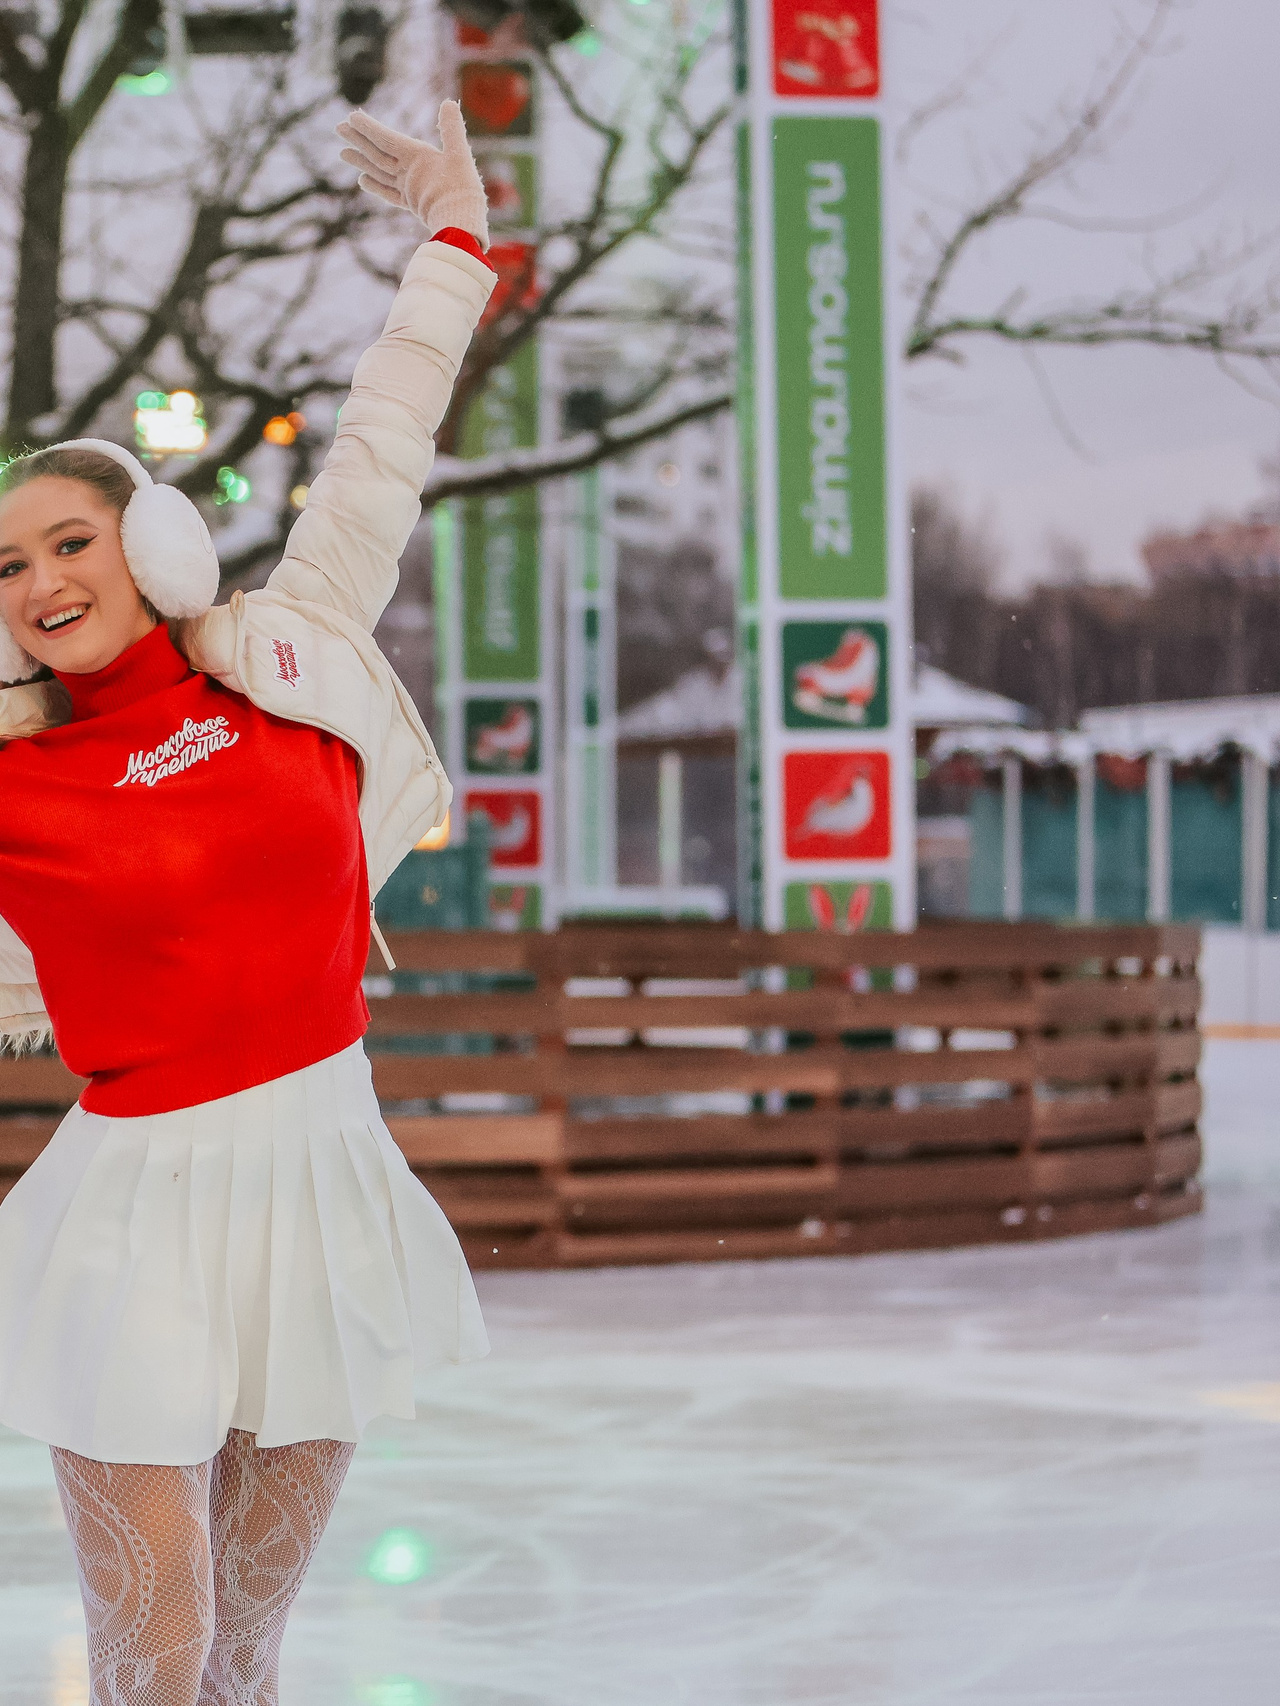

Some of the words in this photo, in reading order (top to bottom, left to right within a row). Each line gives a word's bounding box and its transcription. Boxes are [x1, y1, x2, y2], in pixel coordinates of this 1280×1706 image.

[802, 161, 852, 557] zima.mos.ru
[113, 715, 230, 787] Московское
[131, 728, 240, 787] чаепитие
